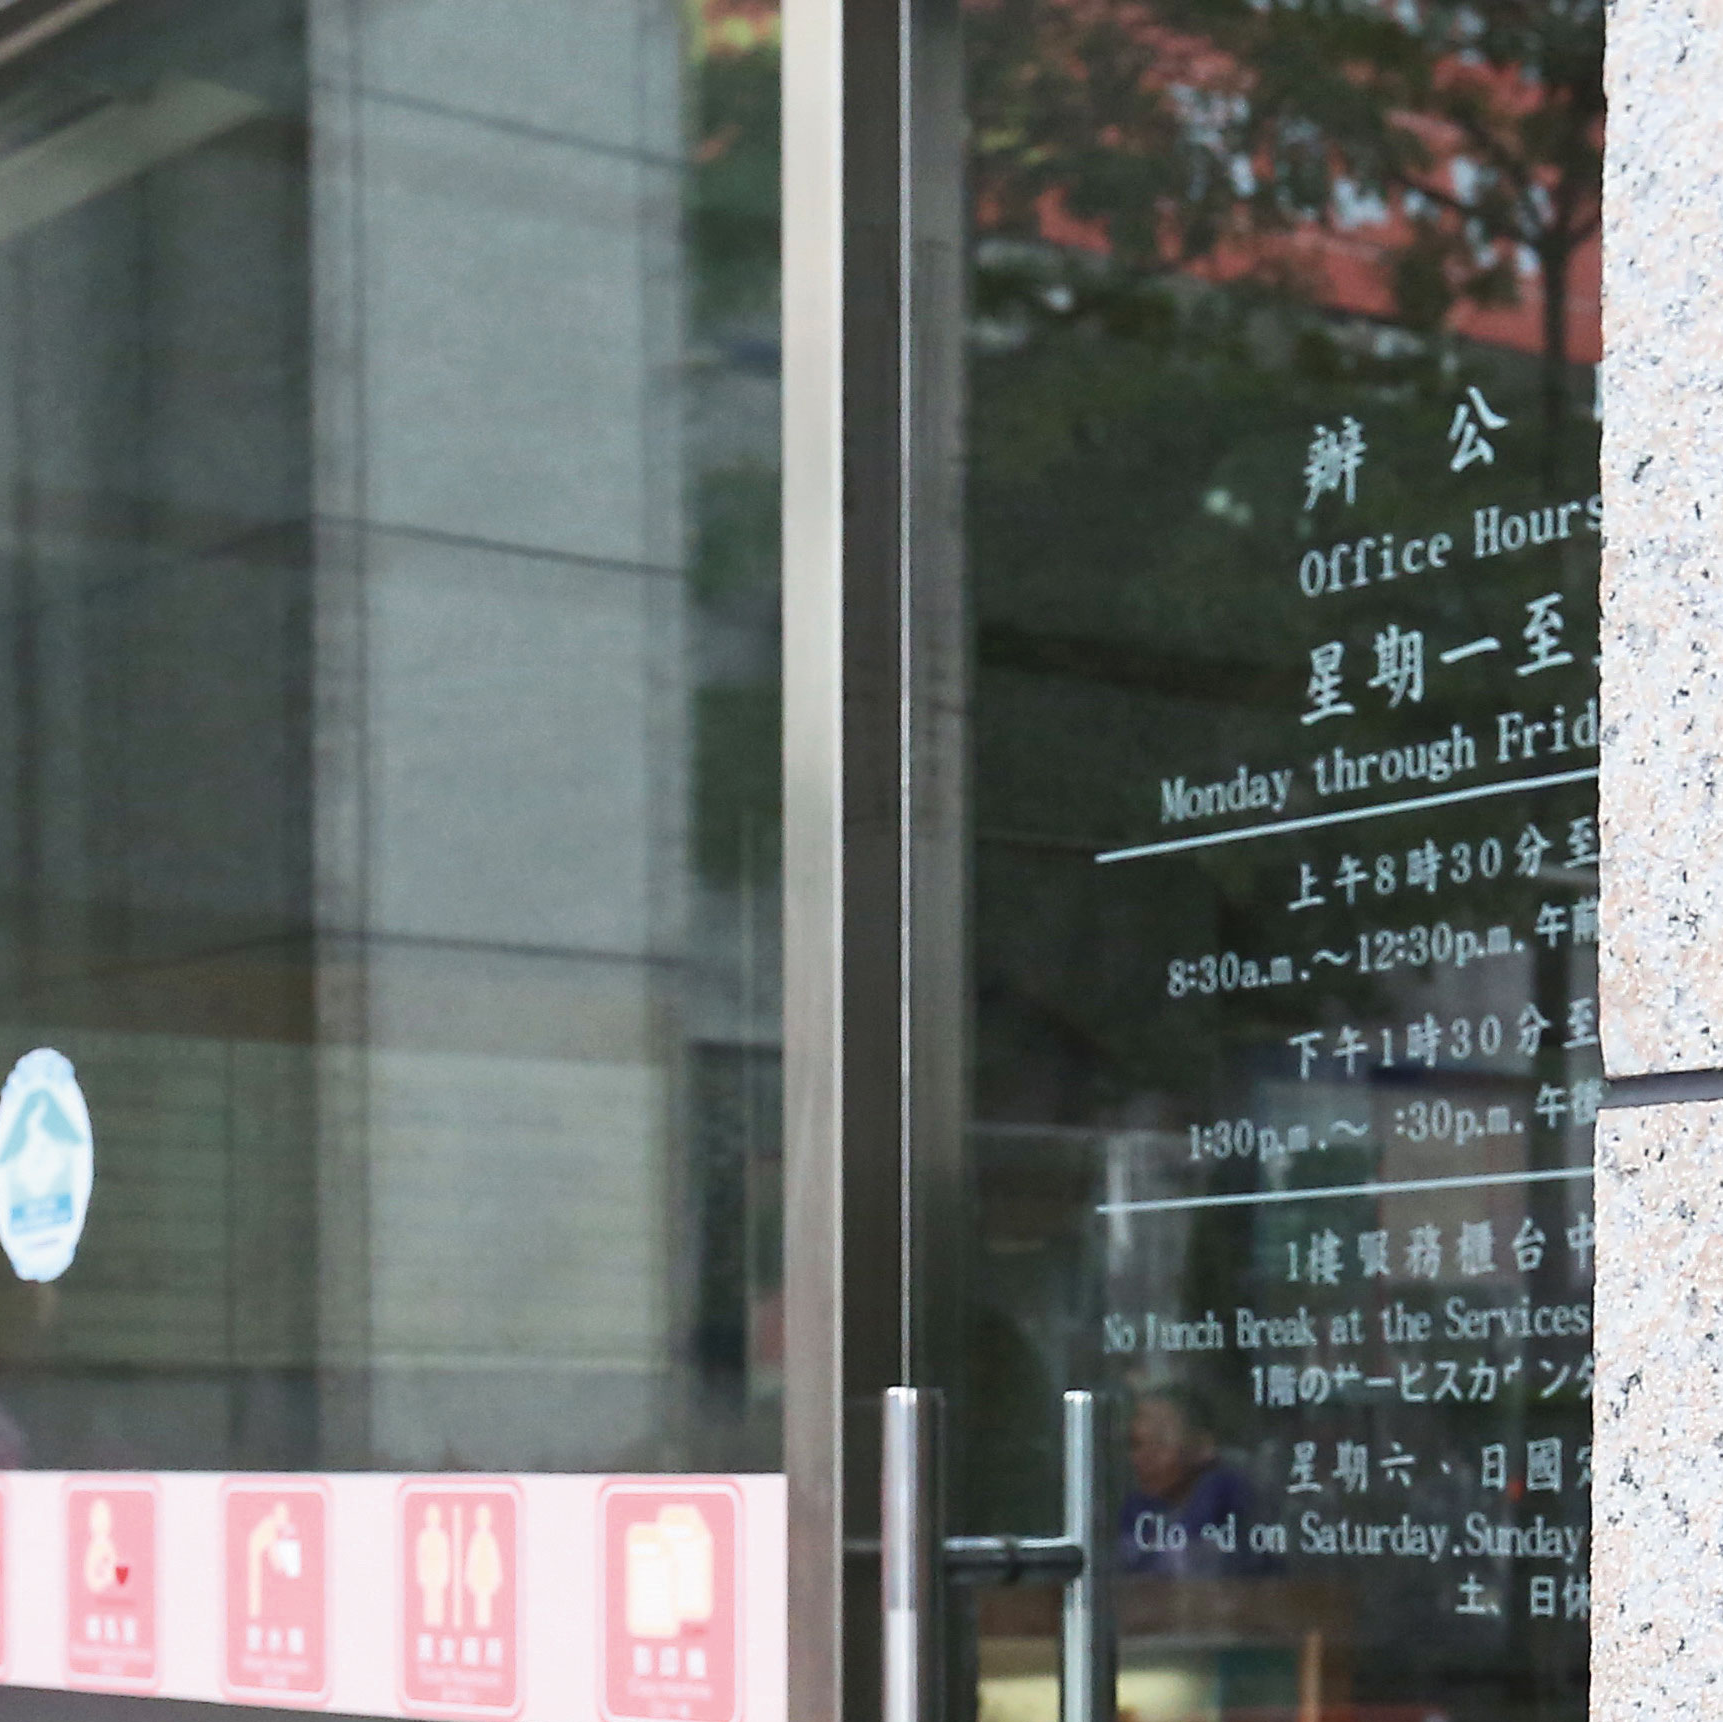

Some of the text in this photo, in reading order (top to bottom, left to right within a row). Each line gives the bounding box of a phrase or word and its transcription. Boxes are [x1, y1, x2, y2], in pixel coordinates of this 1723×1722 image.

[1302, 362, 1603, 511] 辦公
[1298, 493, 1603, 599] Office Hours
[1300, 592, 1600, 727] 星期一至
[1160, 764, 1293, 825] Monday
[1312, 723, 1477, 796] through
[1103, 1314, 1137, 1355] No
[1235, 1305, 1318, 1349] Break
[1329, 1306, 1366, 1347] at
[1382, 1302, 1433, 1344] the
[1134, 1511, 1237, 1553] Cloed
[1248, 1519, 1288, 1554] on
